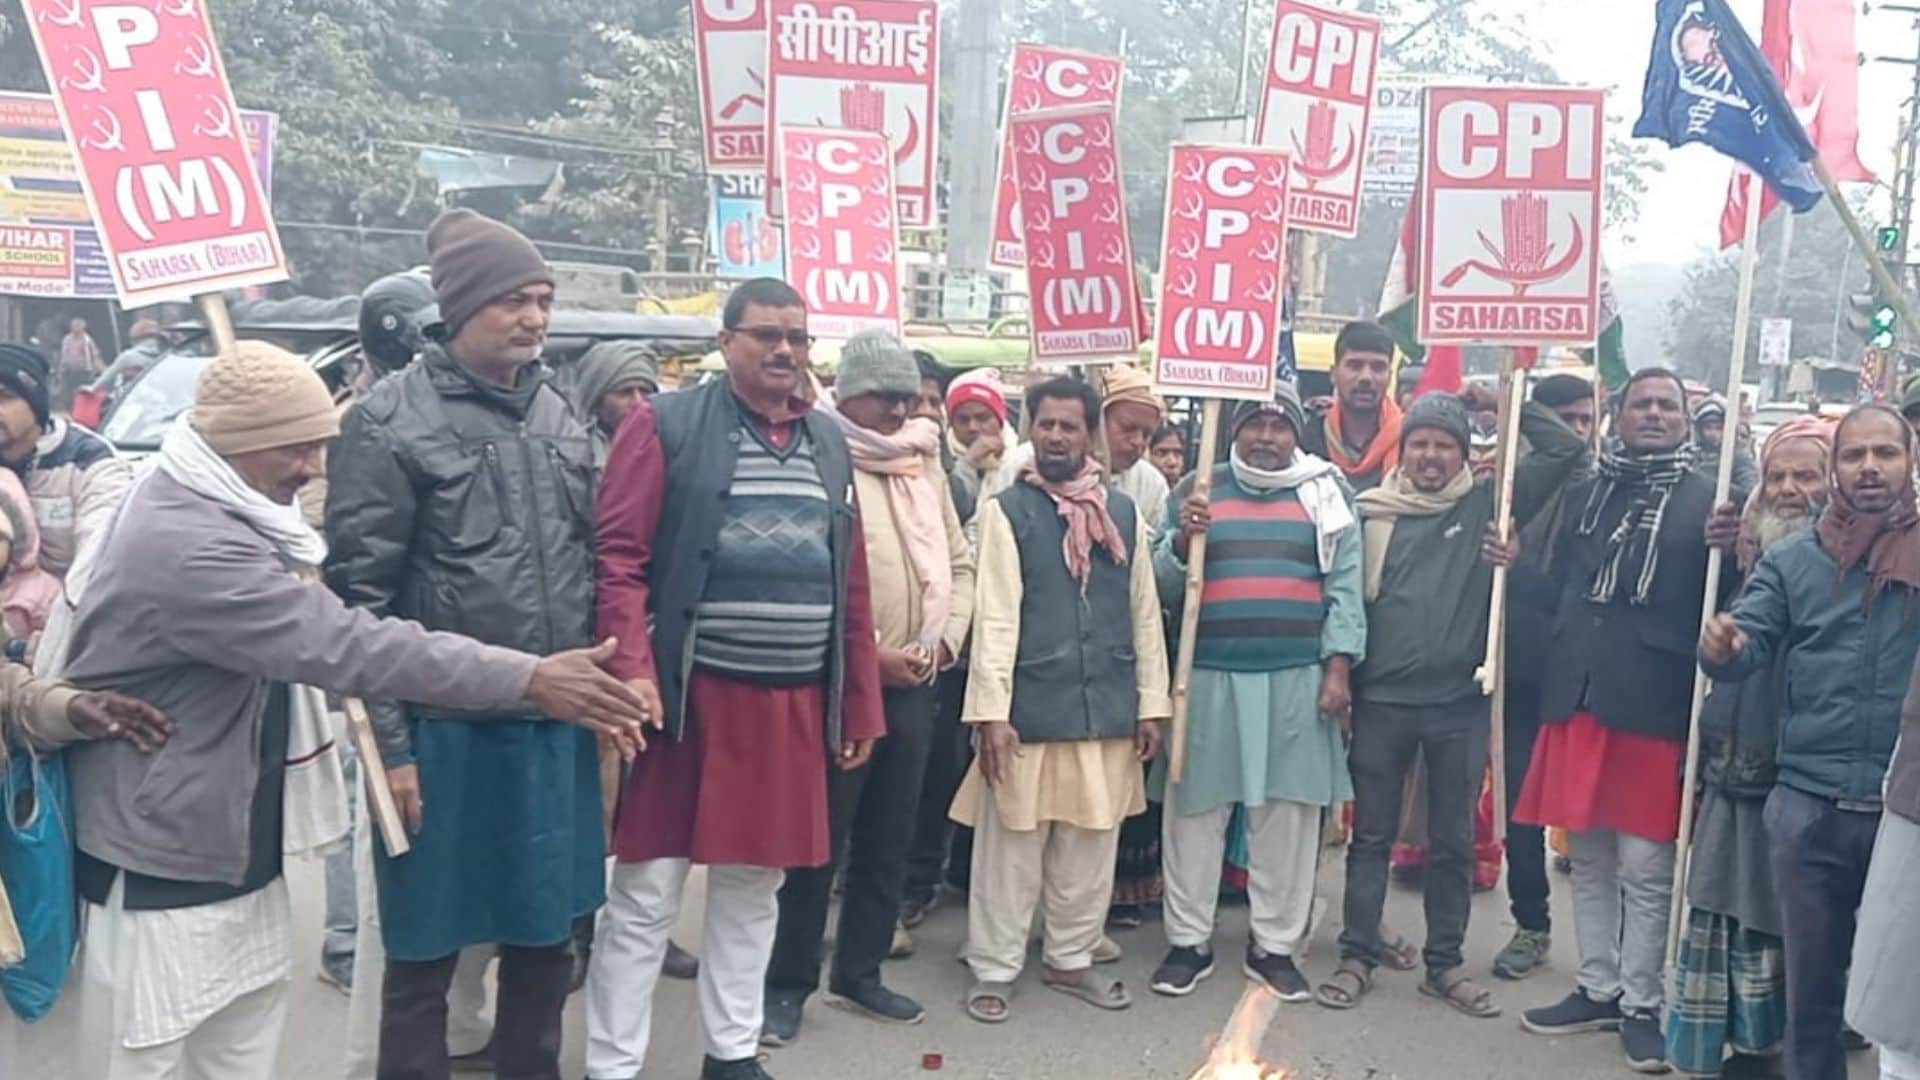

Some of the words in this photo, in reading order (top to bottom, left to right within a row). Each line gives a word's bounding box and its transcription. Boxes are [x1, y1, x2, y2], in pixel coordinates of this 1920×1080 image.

[776, 3, 932, 76] सीपीआई
[1274, 12, 1375, 97] CPI
[1436, 100, 1595, 180] CPI
[1885, 229, 1897, 249] 7
[1434, 305, 1584, 332] SAHARSA
